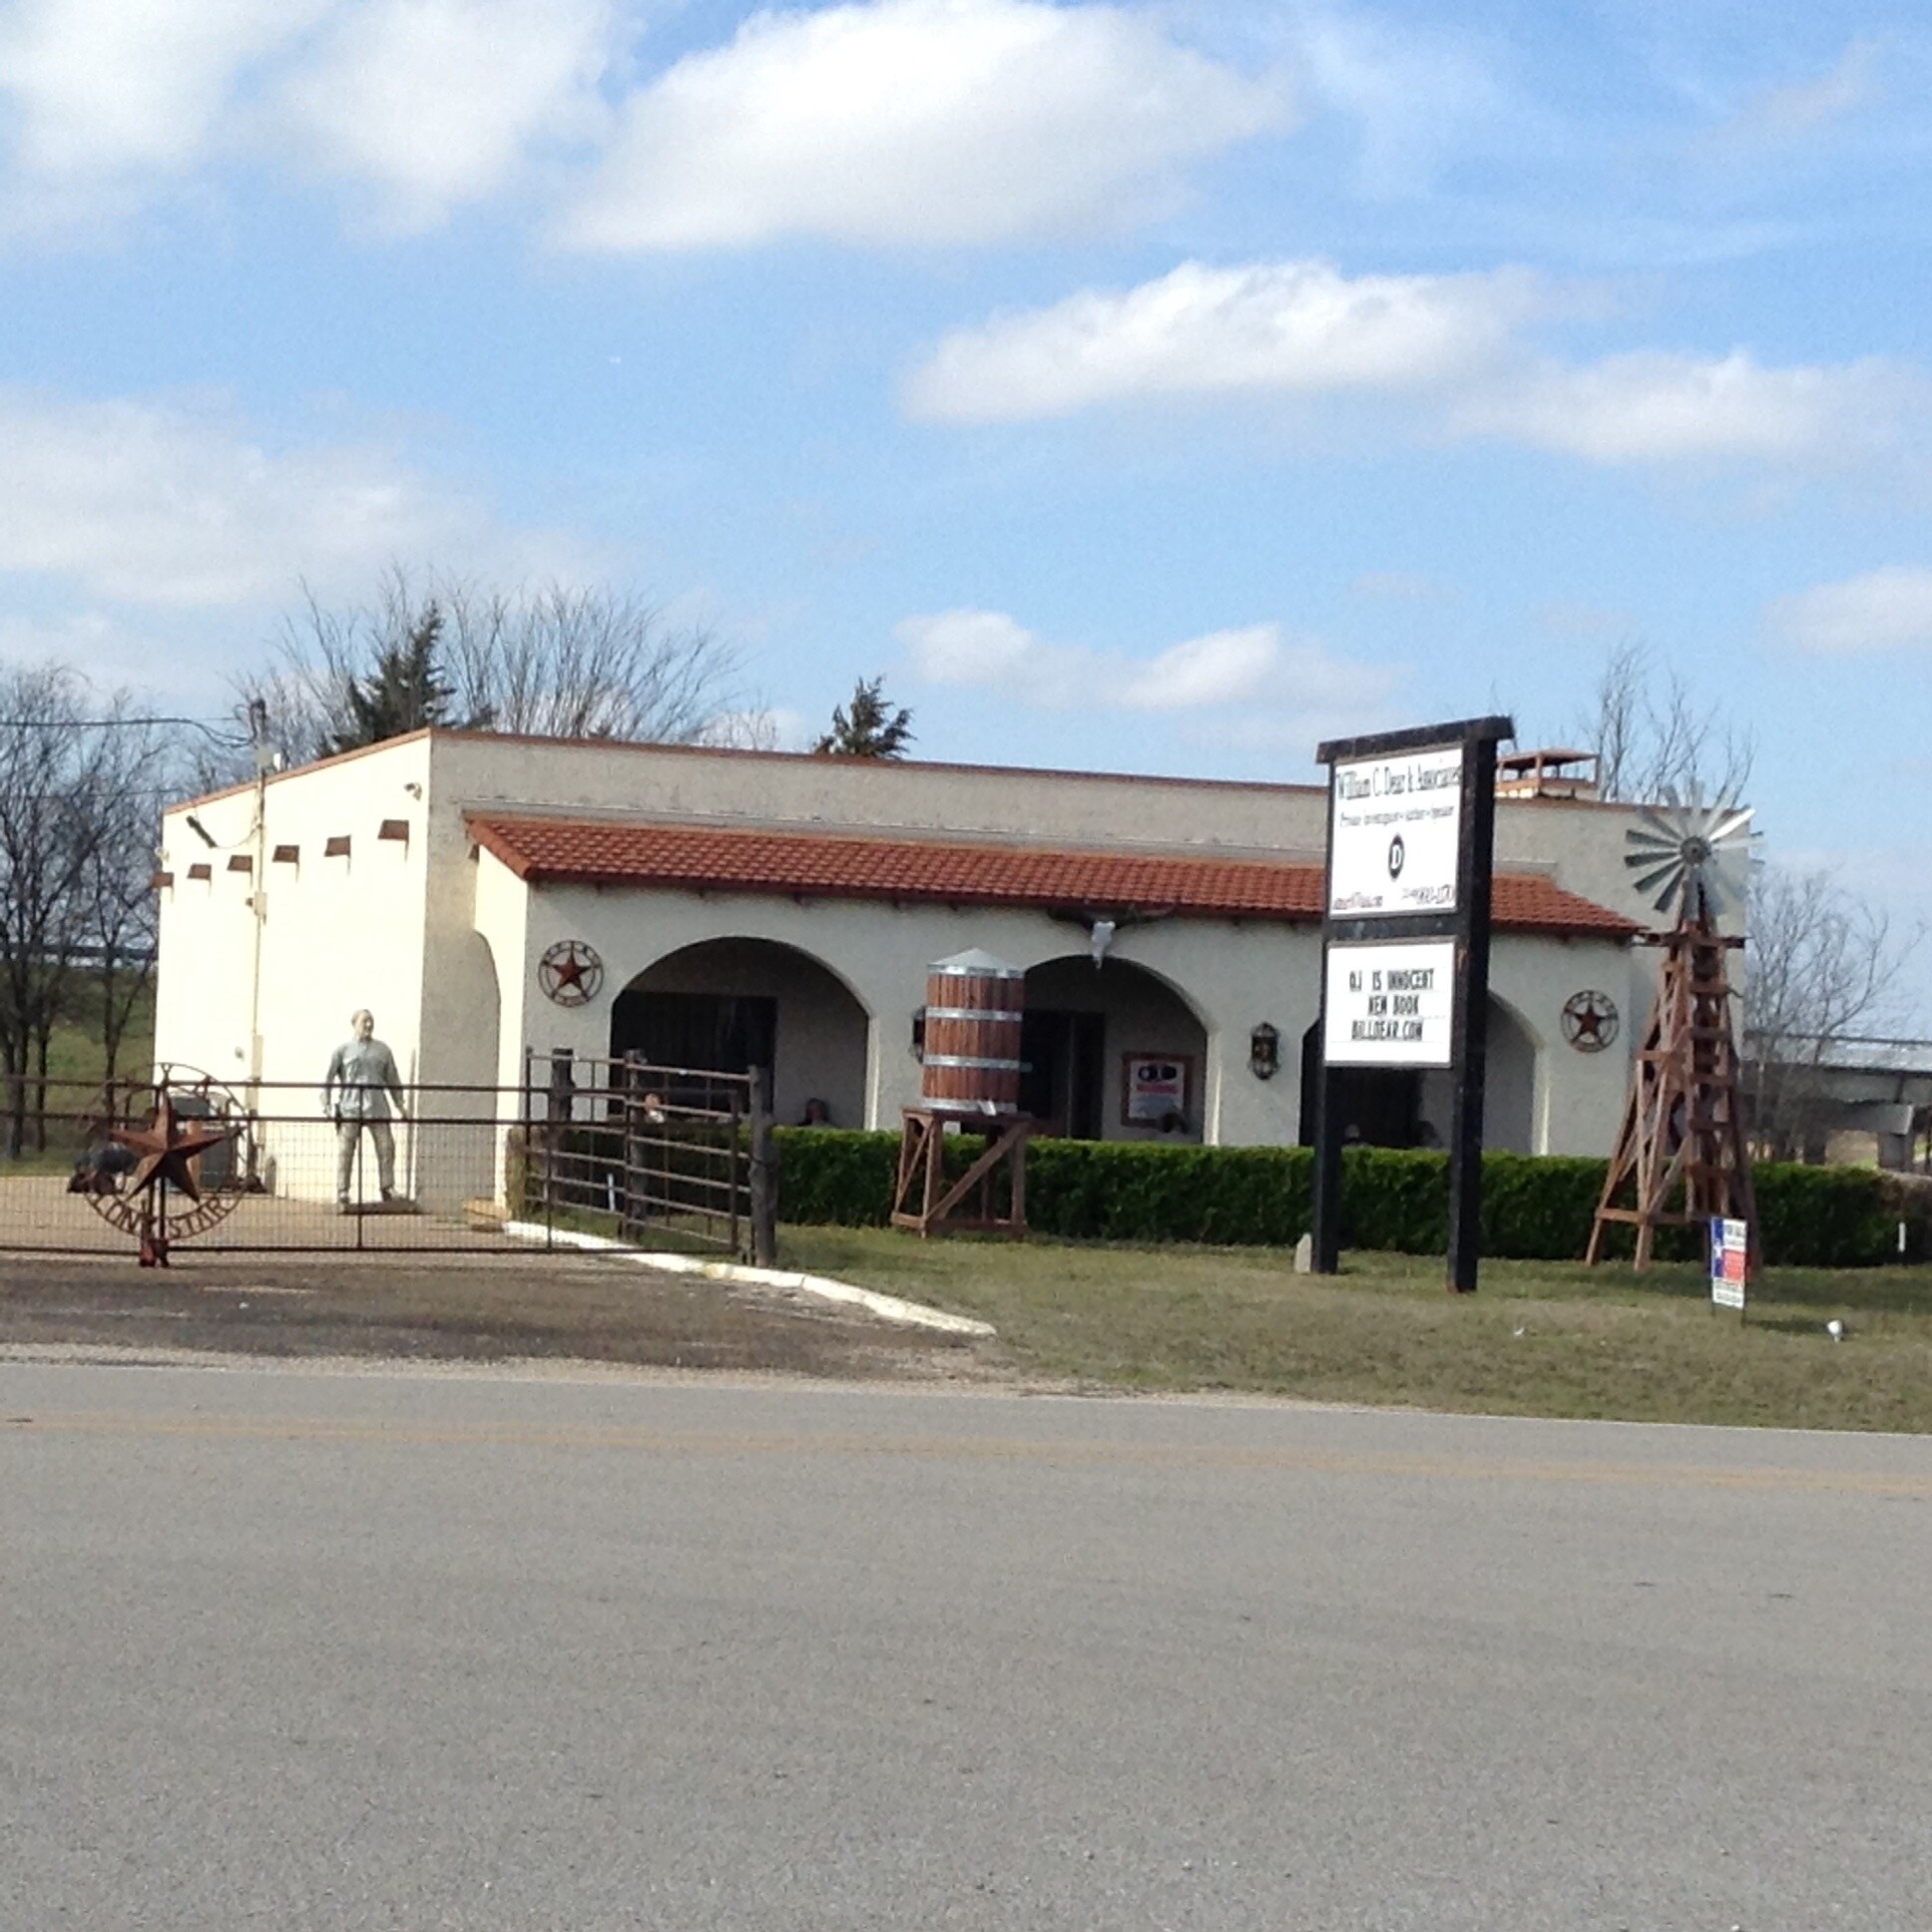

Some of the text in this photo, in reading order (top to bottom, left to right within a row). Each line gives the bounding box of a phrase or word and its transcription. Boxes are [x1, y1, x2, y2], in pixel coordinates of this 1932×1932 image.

[1372, 970, 1381, 991] IS
[1368, 994, 1419, 1016] NEW BOOK
[168, 1196, 228, 1238] STAR
